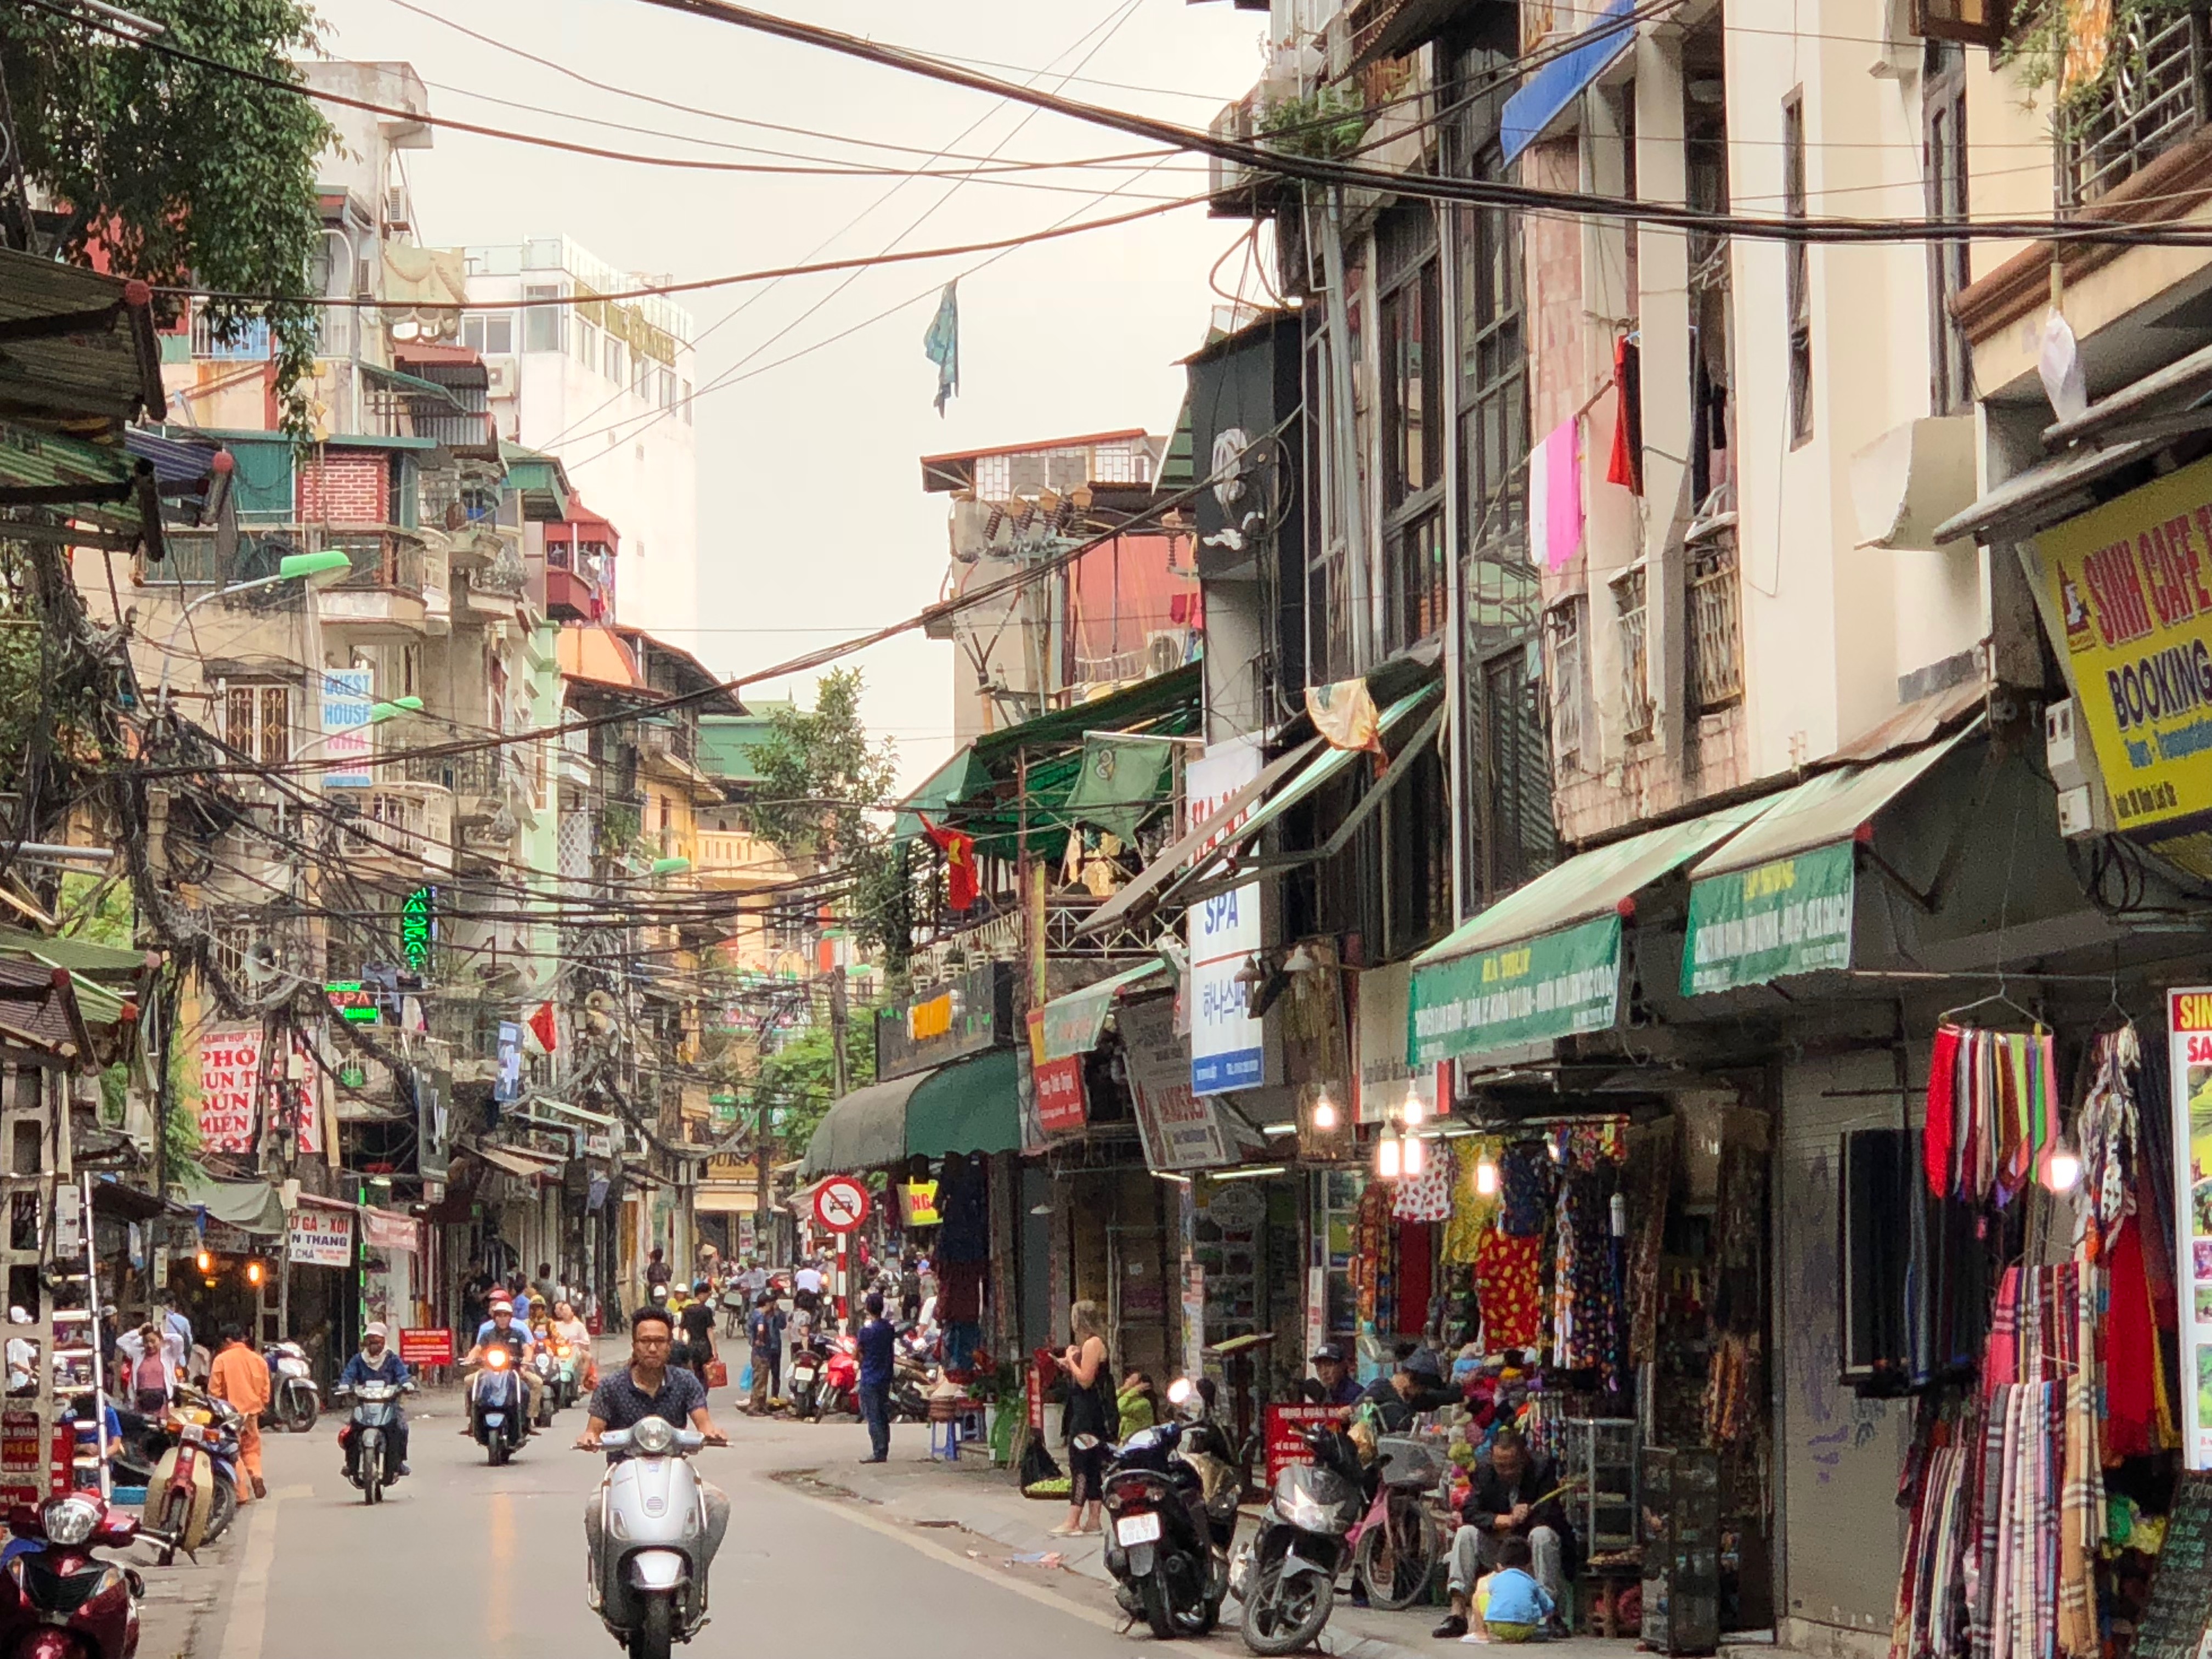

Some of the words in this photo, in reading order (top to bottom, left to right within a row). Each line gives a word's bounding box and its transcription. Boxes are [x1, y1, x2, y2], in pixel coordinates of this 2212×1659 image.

[2083, 539, 2153, 646] SINH
[325, 674, 370, 696] GUEST
[2107, 638, 2212, 730] BOOKING
[1205, 890, 1239, 935] SPA
[305, 1234, 347, 1247] THANG
